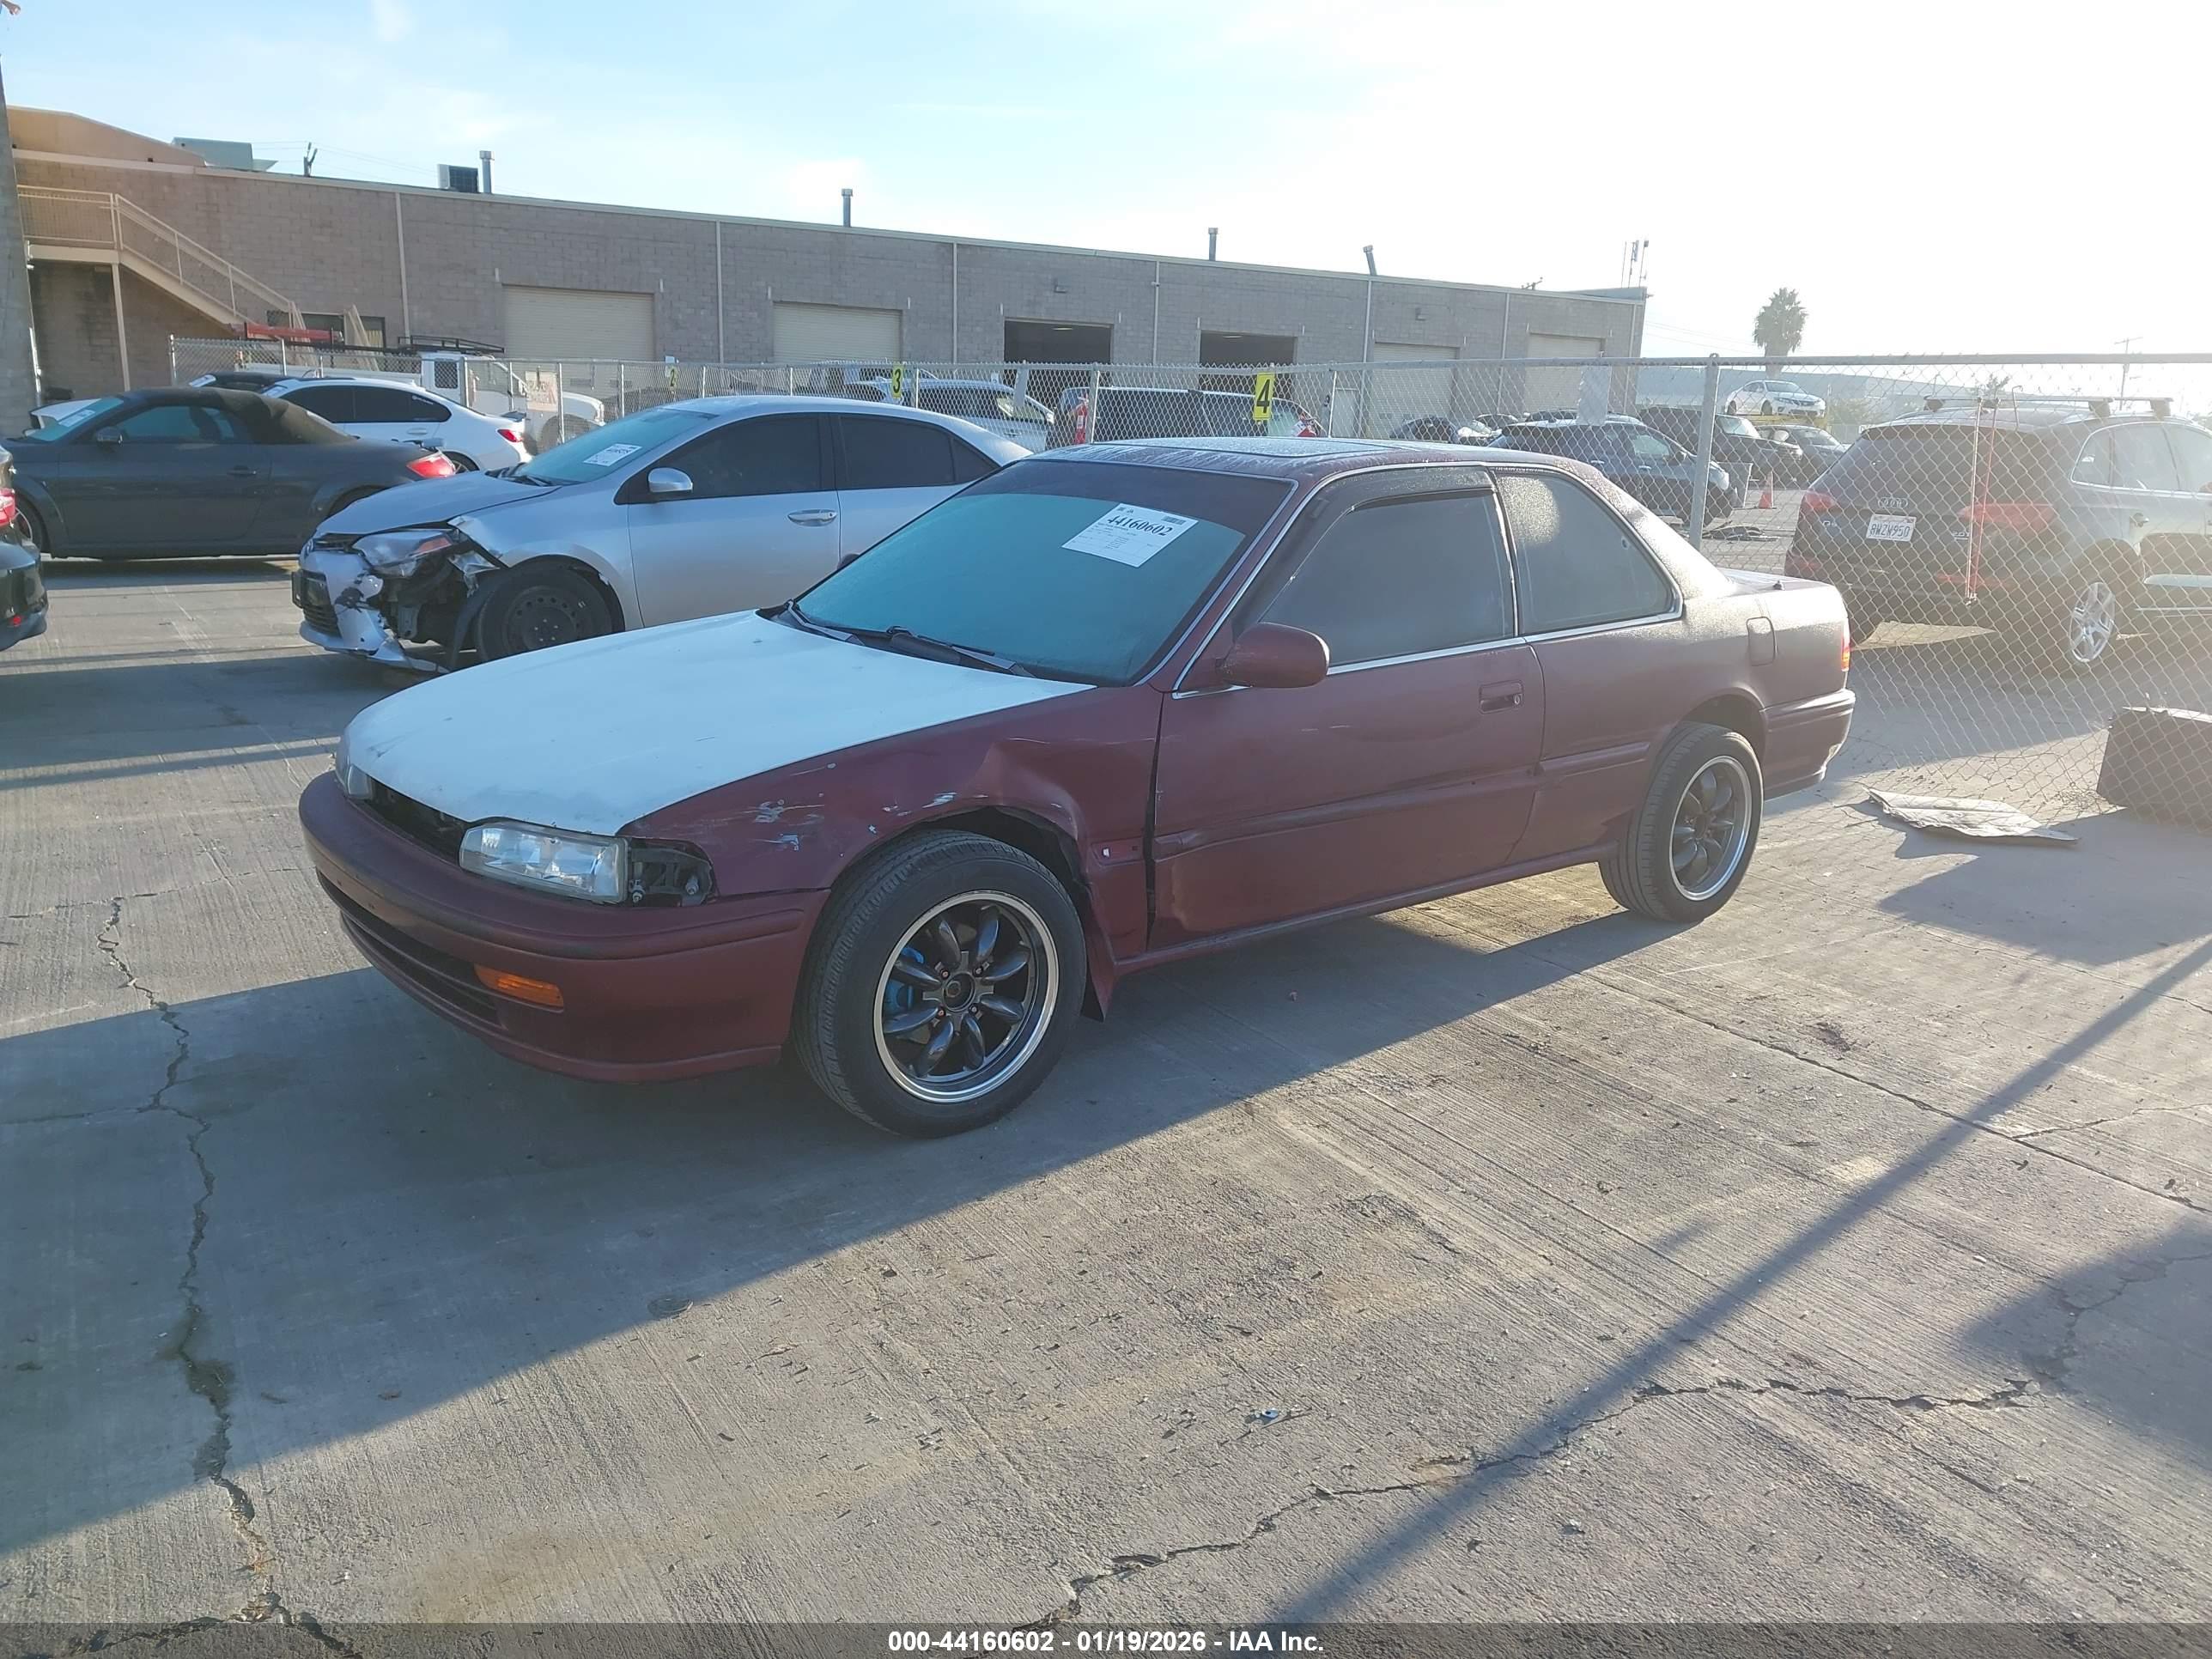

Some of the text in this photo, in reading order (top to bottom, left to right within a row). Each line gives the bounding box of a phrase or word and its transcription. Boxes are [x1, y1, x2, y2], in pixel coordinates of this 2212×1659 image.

[670, 368, 676, 387] 2
[893, 368, 902, 393] 3
[1255, 379, 1270, 414] 4
[1106, 515, 1174, 537] 44160602
